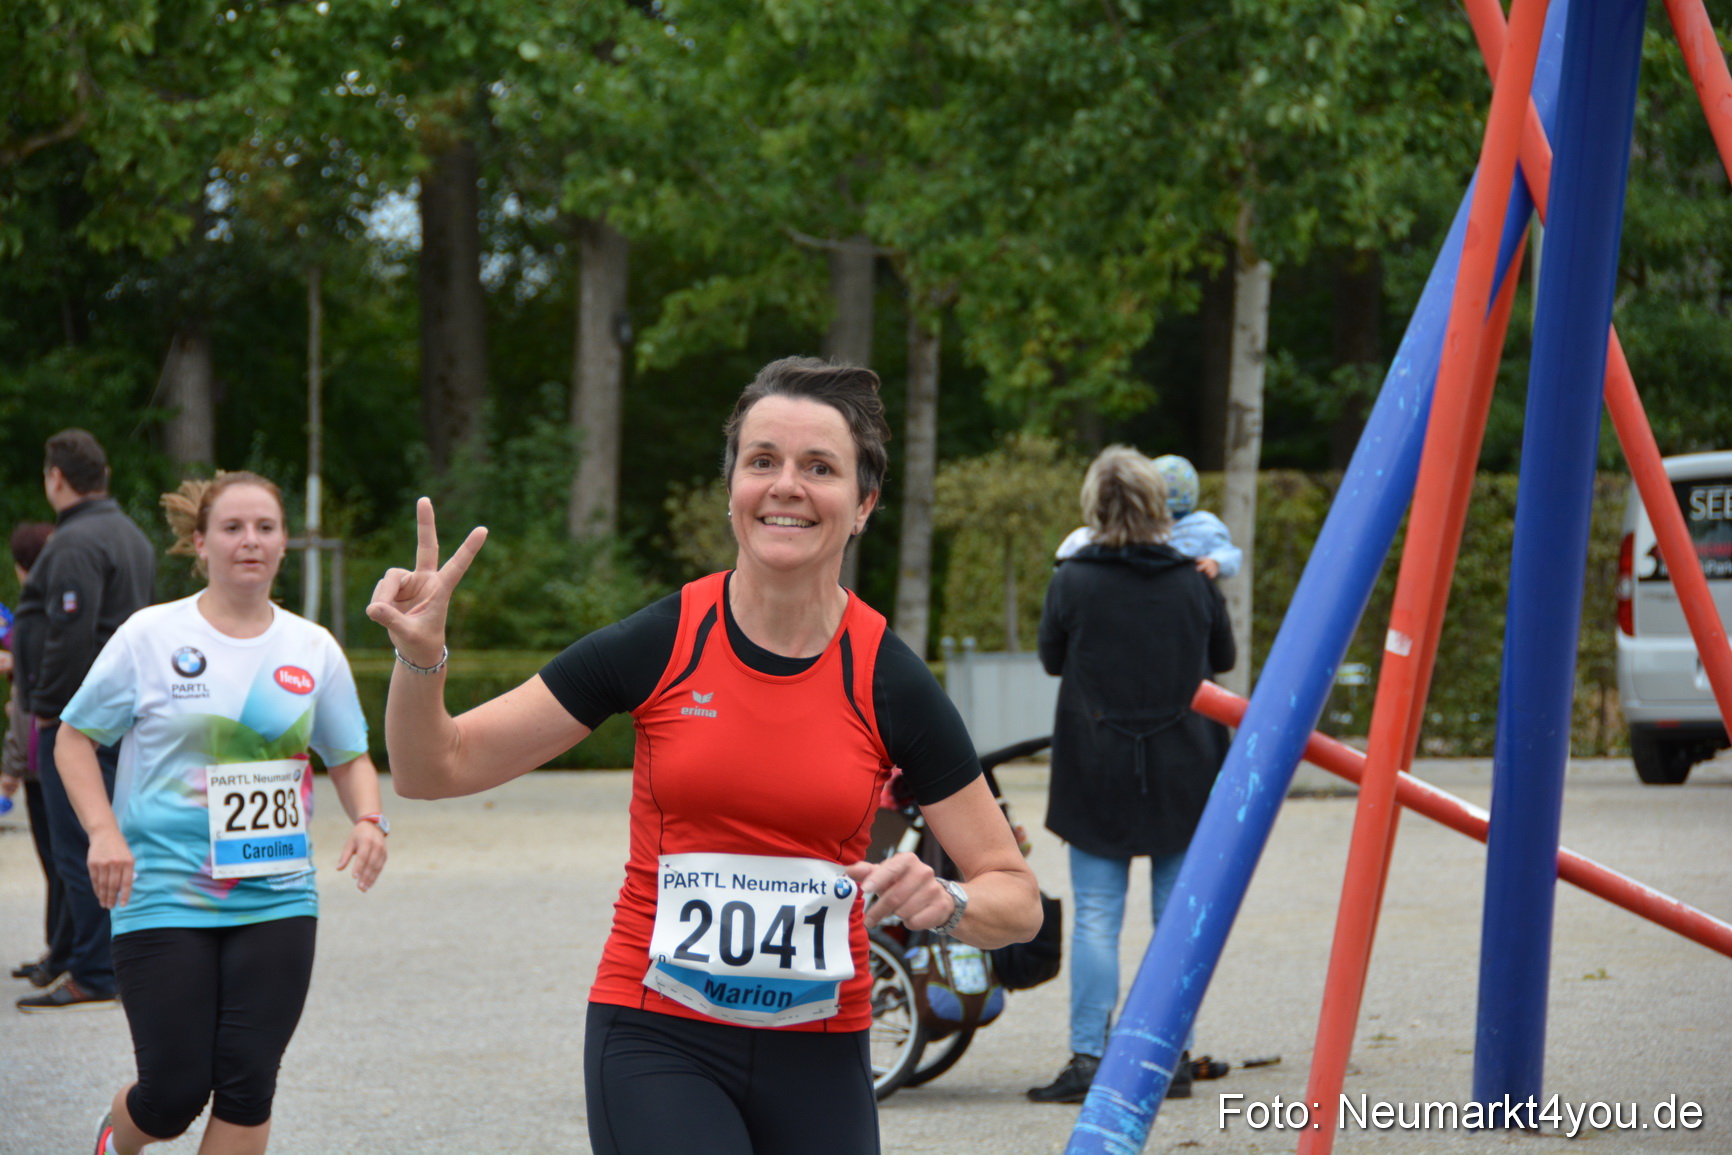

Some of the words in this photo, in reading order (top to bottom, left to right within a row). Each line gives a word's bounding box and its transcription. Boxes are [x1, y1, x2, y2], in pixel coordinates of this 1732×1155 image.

[172, 683, 208, 693] PARTL
[681, 705, 717, 718] erima
[210, 774, 251, 787] PARTL
[223, 787, 299, 832] 2283
[242, 841, 294, 860] Caroline
[663, 872, 726, 889] PARTL
[732, 873, 827, 895] Neumarkt
[673, 899, 829, 970] 2041
[704, 978, 793, 1008] Marion
